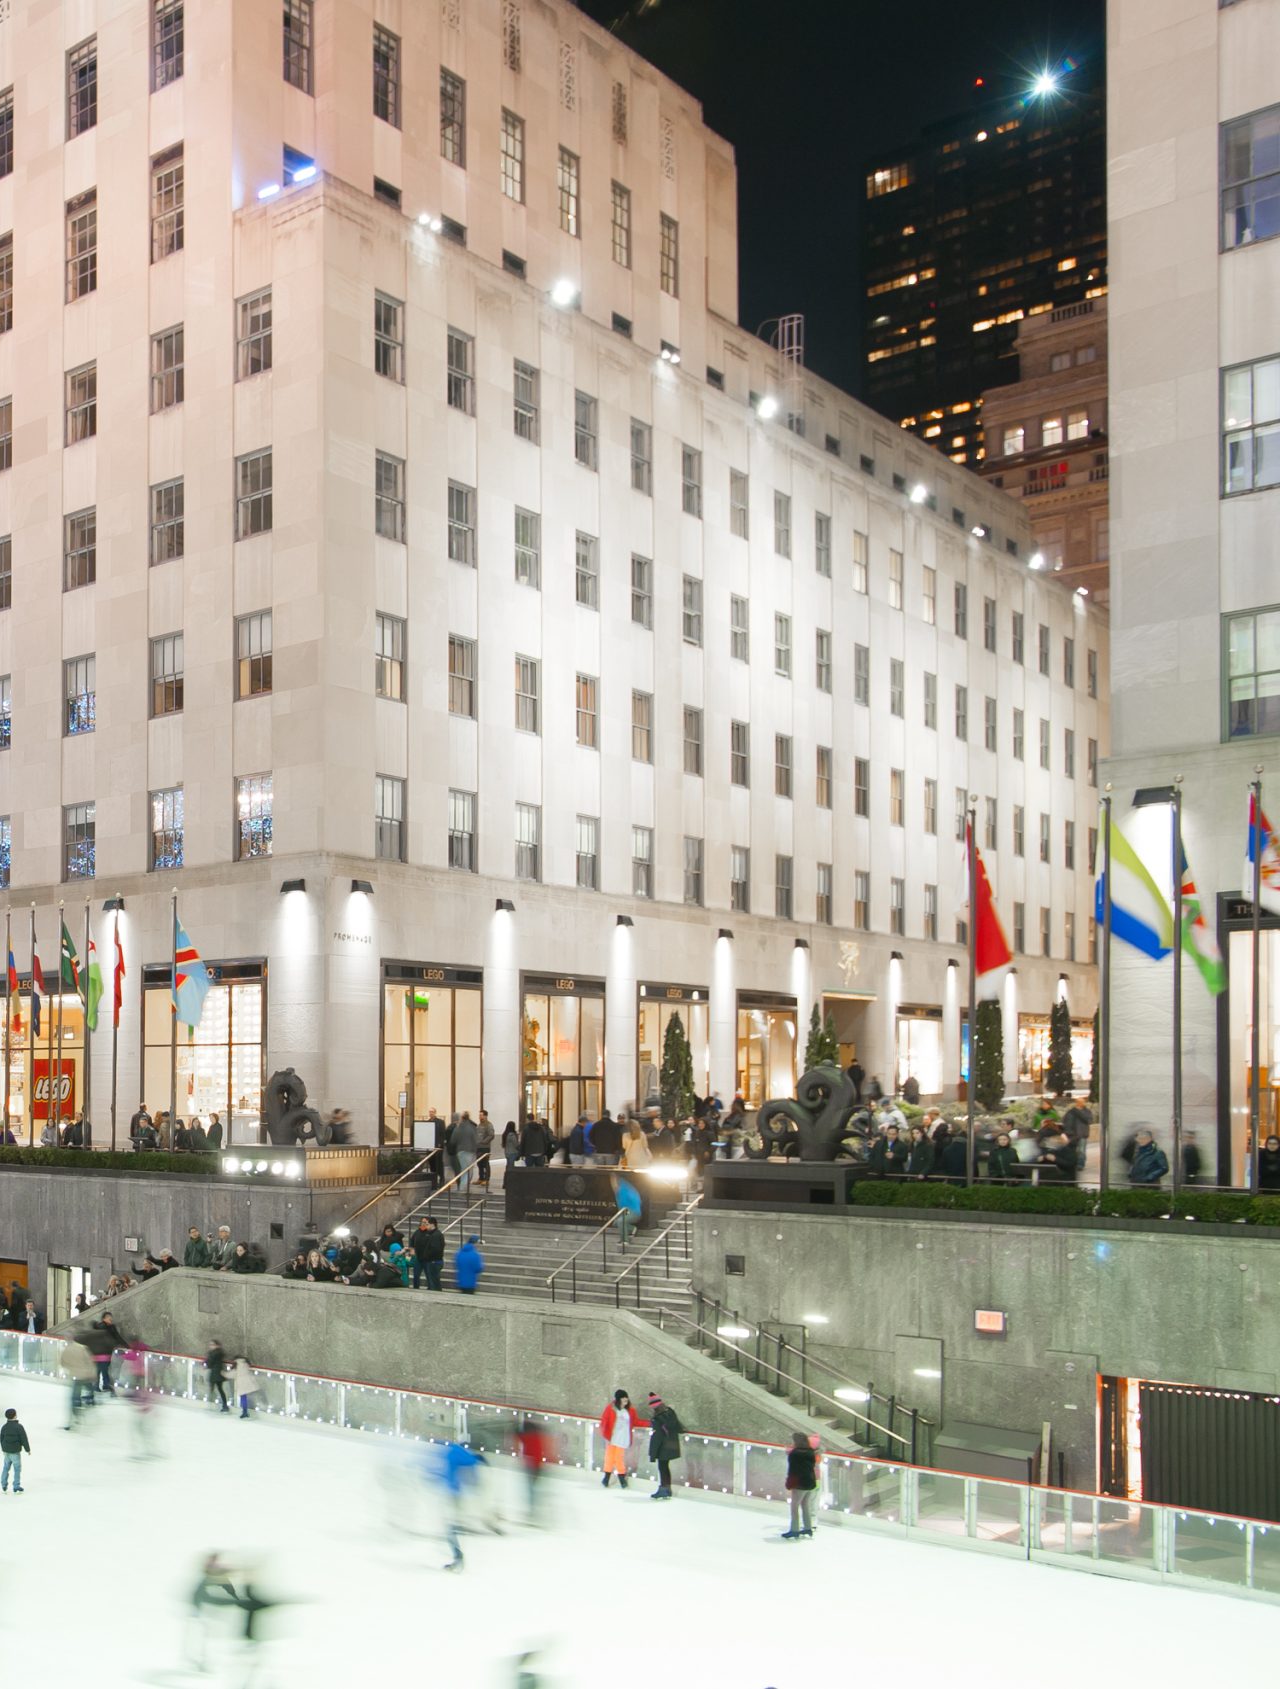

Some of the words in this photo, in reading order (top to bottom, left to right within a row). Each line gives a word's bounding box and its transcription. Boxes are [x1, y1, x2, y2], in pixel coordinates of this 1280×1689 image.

[1233, 904, 1254, 914] TH
[423, 968, 445, 980] LEGO
[17, 979, 32, 990] LEG
[555, 979, 575, 990] LEGO
[34, 1076, 72, 1102] LEGO
